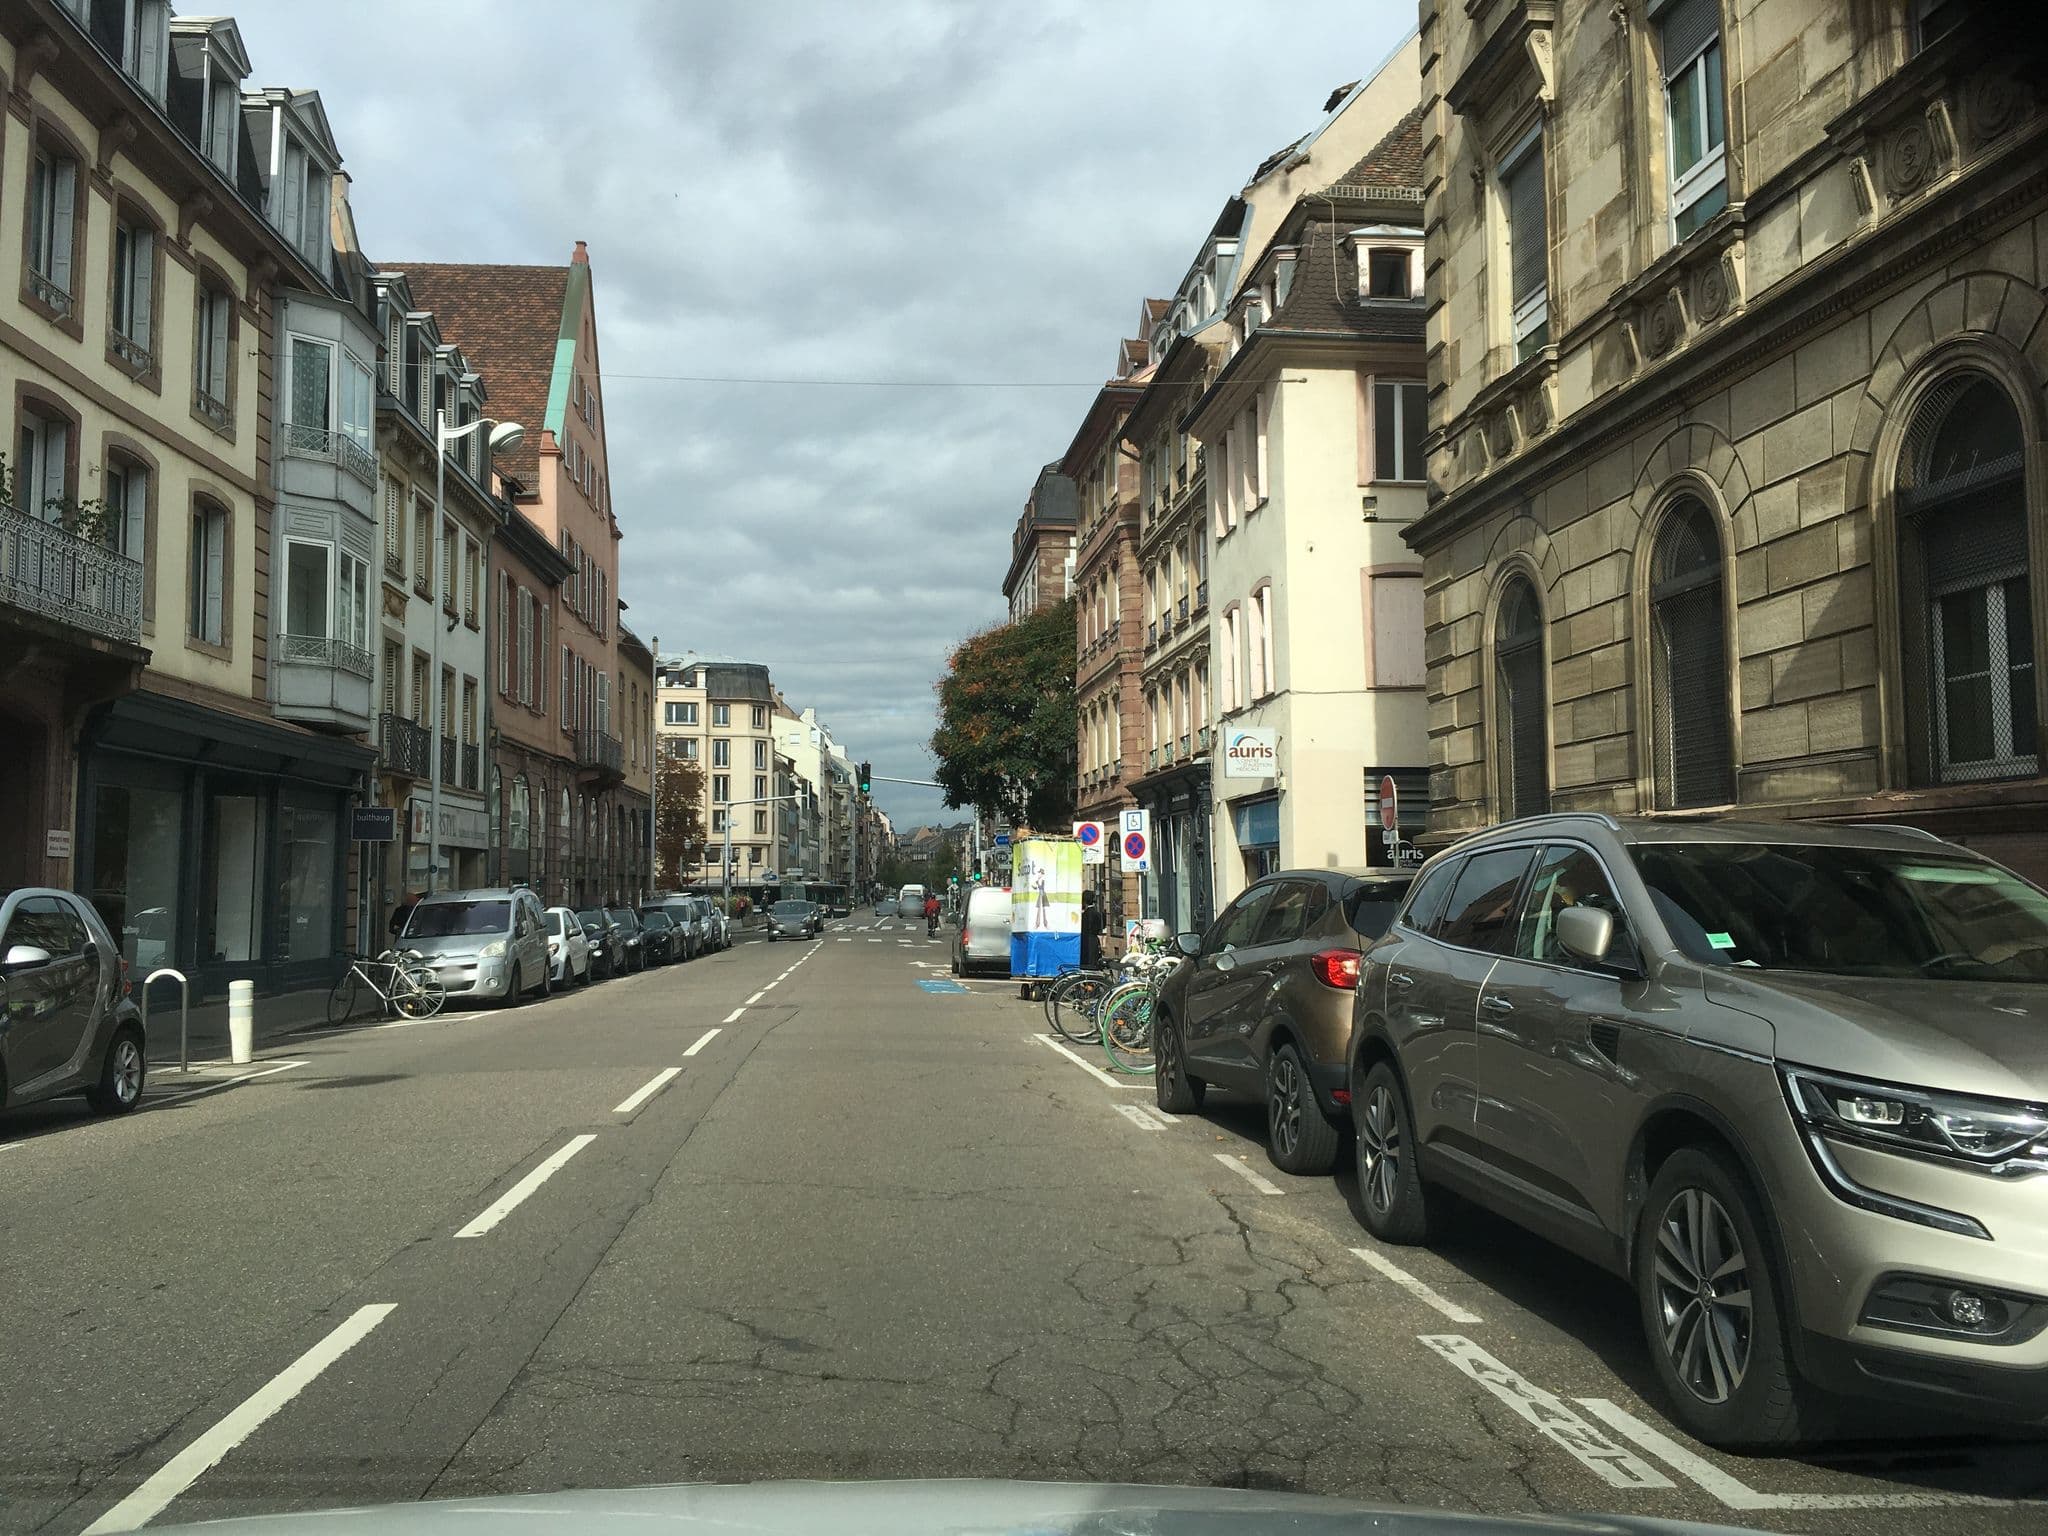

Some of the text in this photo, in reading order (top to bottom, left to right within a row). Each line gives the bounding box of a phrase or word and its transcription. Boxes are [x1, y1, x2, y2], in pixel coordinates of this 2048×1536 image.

[1228, 742, 1273, 758] auris
[356, 813, 391, 823] bulthaup
[1386, 846, 1424, 860] auris
[1427, 1337, 1650, 1484] PAYANT
